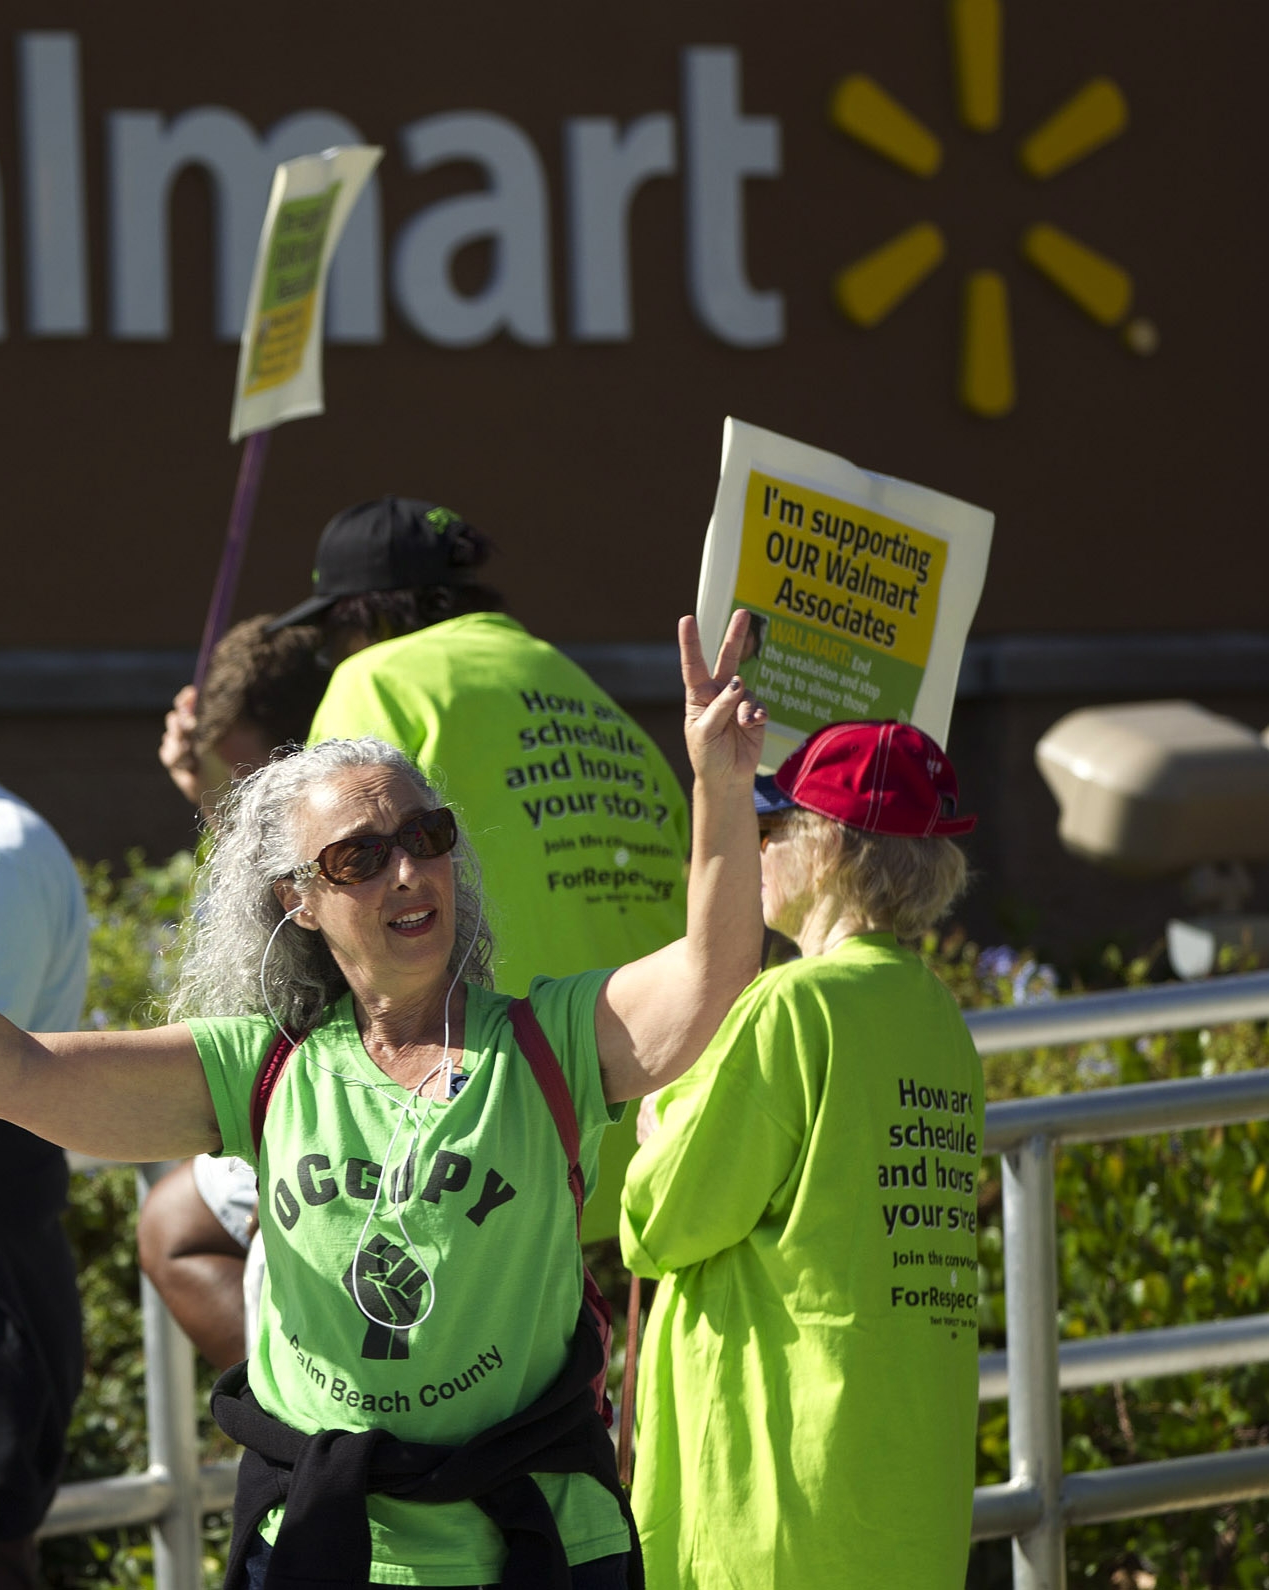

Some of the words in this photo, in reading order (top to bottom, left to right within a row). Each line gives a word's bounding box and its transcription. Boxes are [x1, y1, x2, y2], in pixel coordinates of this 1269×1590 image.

[763, 486, 804, 528] I'm
[810, 507, 931, 584] supporting
[766, 532, 820, 577] OUR
[825, 551, 920, 616] Walmart
[774, 577, 898, 649] Associates
[771, 618, 852, 667] WALMART:
[851, 655, 872, 676] End
[760, 664, 793, 691] trying
[794, 675, 807, 693] to
[807, 681, 841, 706] silence
[842, 691, 870, 716] those
[765, 645, 783, 662] the
[785, 654, 839, 685] retaliation
[839, 673, 859, 691] and
[859, 680, 881, 702] stop
[520, 689, 587, 718] How
[755, 684, 780, 700] who
[782, 691, 813, 716] speak
[506, 751, 572, 789] and
[578, 751, 646, 793] hous
[523, 793, 597, 830] your
[898, 1078, 949, 1111] How
[275, 1149, 518, 1231] OCCUPY
[878, 1156, 928, 1190] and
[935, 1157, 974, 1195] hors
[882, 1204, 944, 1237] your
[893, 1250, 925, 1269] Join
[928, 1249, 943, 1266] the
[330, 1377, 411, 1414] Beach
[418, 1344, 505, 1409] County
